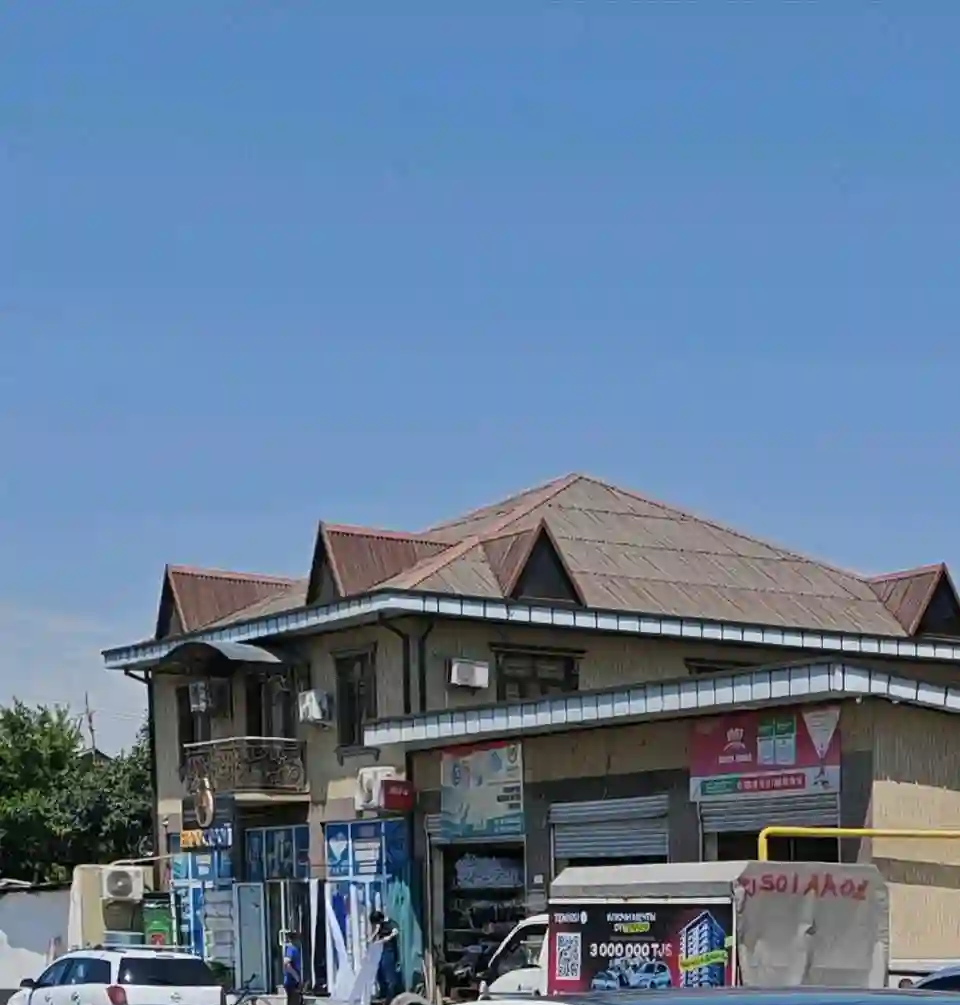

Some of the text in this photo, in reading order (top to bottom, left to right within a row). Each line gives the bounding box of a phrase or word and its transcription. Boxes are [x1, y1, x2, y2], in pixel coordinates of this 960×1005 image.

[589, 943, 673, 957] 3 000 000 TJS
